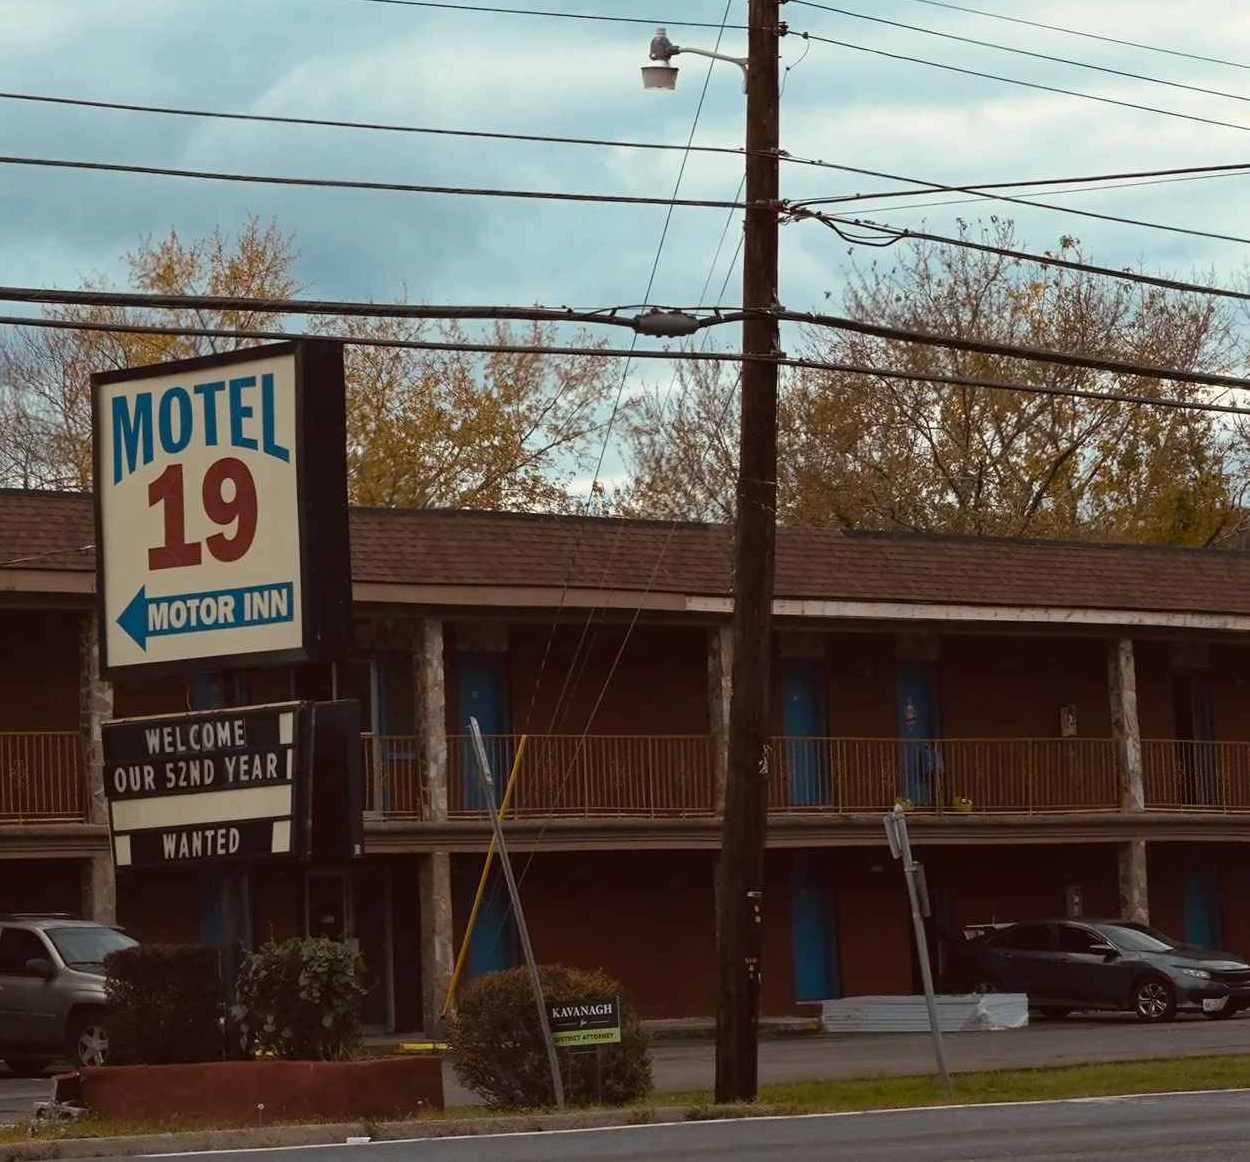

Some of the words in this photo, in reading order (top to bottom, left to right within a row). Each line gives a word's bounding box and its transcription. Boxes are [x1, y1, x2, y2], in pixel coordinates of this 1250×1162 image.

[111, 373, 290, 487] MOTEL
[148, 457, 258, 571] 19
[148, 595, 235, 631] MOTOR
[244, 588, 288, 621] INN
[145, 720, 245, 754] WELCOME
[114, 765, 156, 793] OUR
[165, 758, 215, 788] 52ND
[224, 752, 277, 783] YEAR
[163, 827, 240, 859] WANTED
[552, 1004, 612, 1018] KAVANAGH
